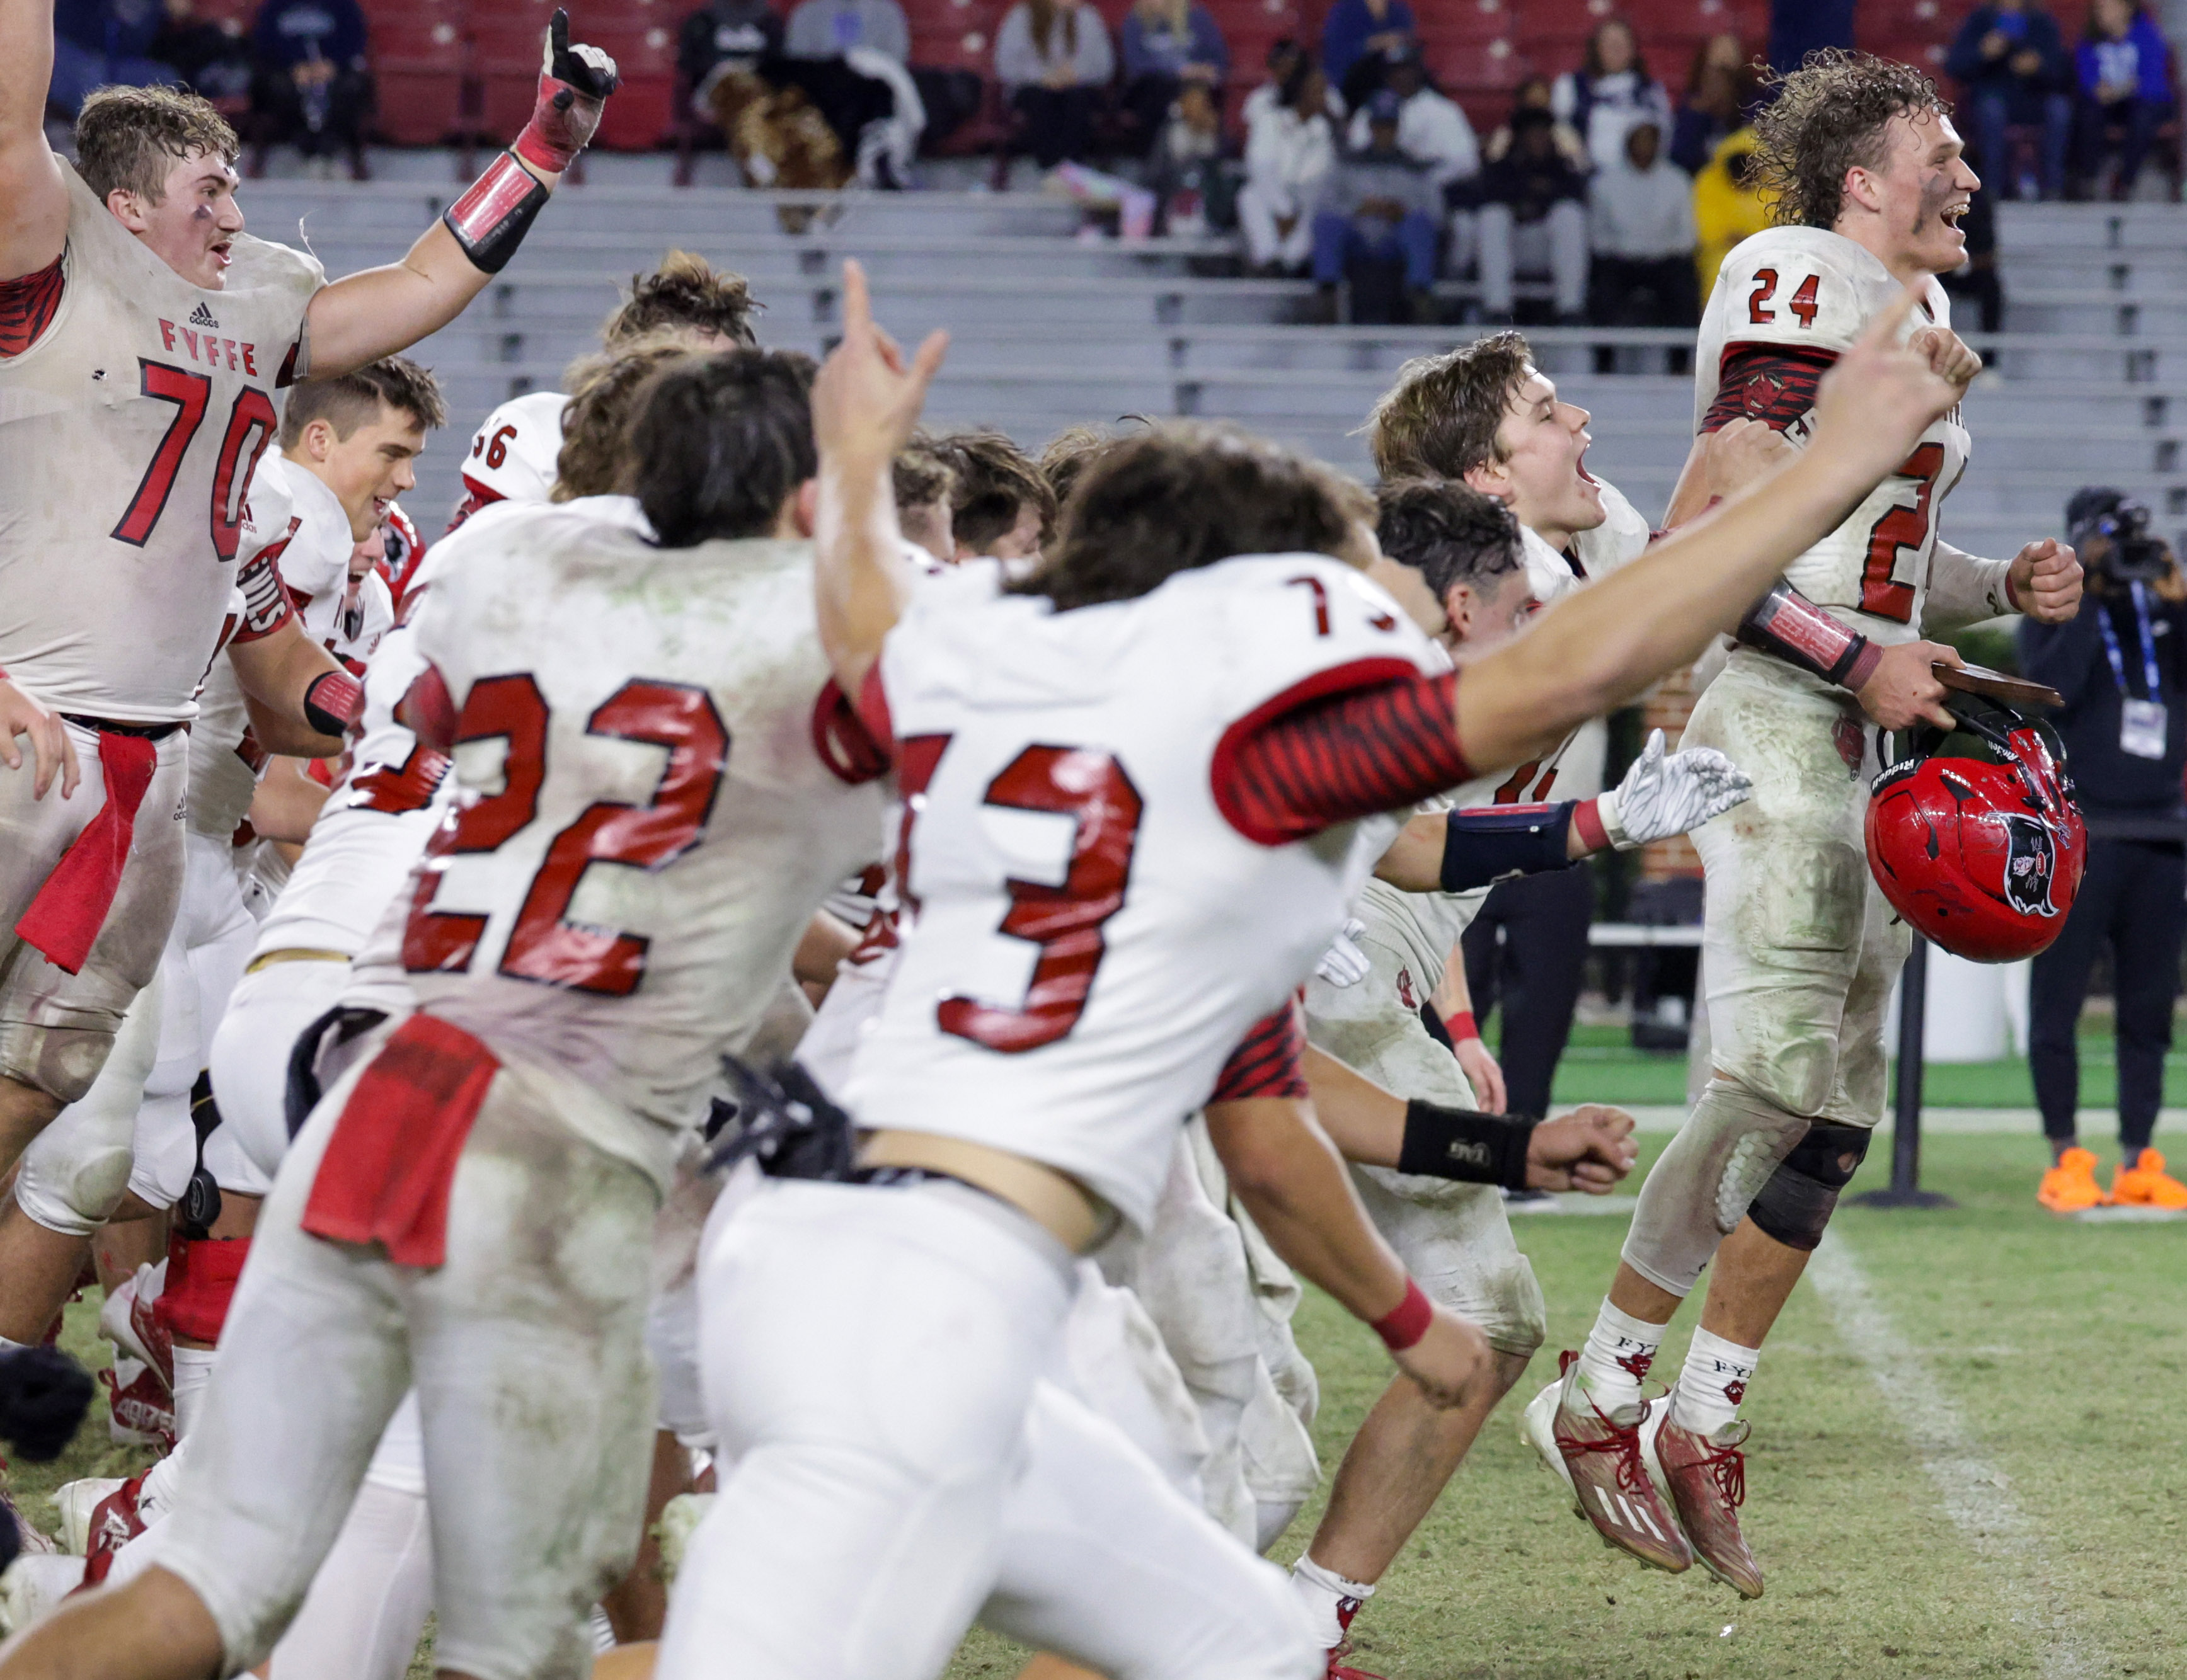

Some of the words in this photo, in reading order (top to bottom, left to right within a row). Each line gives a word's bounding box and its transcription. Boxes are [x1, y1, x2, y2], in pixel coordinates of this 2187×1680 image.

[190, 316, 219, 328] adidas
[1748, 268, 1820, 329] 24
[158, 317, 258, 377] FYFFE
[110, 357, 277, 562] 70
[1858, 442, 1967, 624] 2
[1872, 758, 1915, 791] Riddell
[401, 671, 731, 997] 22
[1616, 1335, 1658, 1354] FY
[1713, 1359, 1753, 1379] FY
